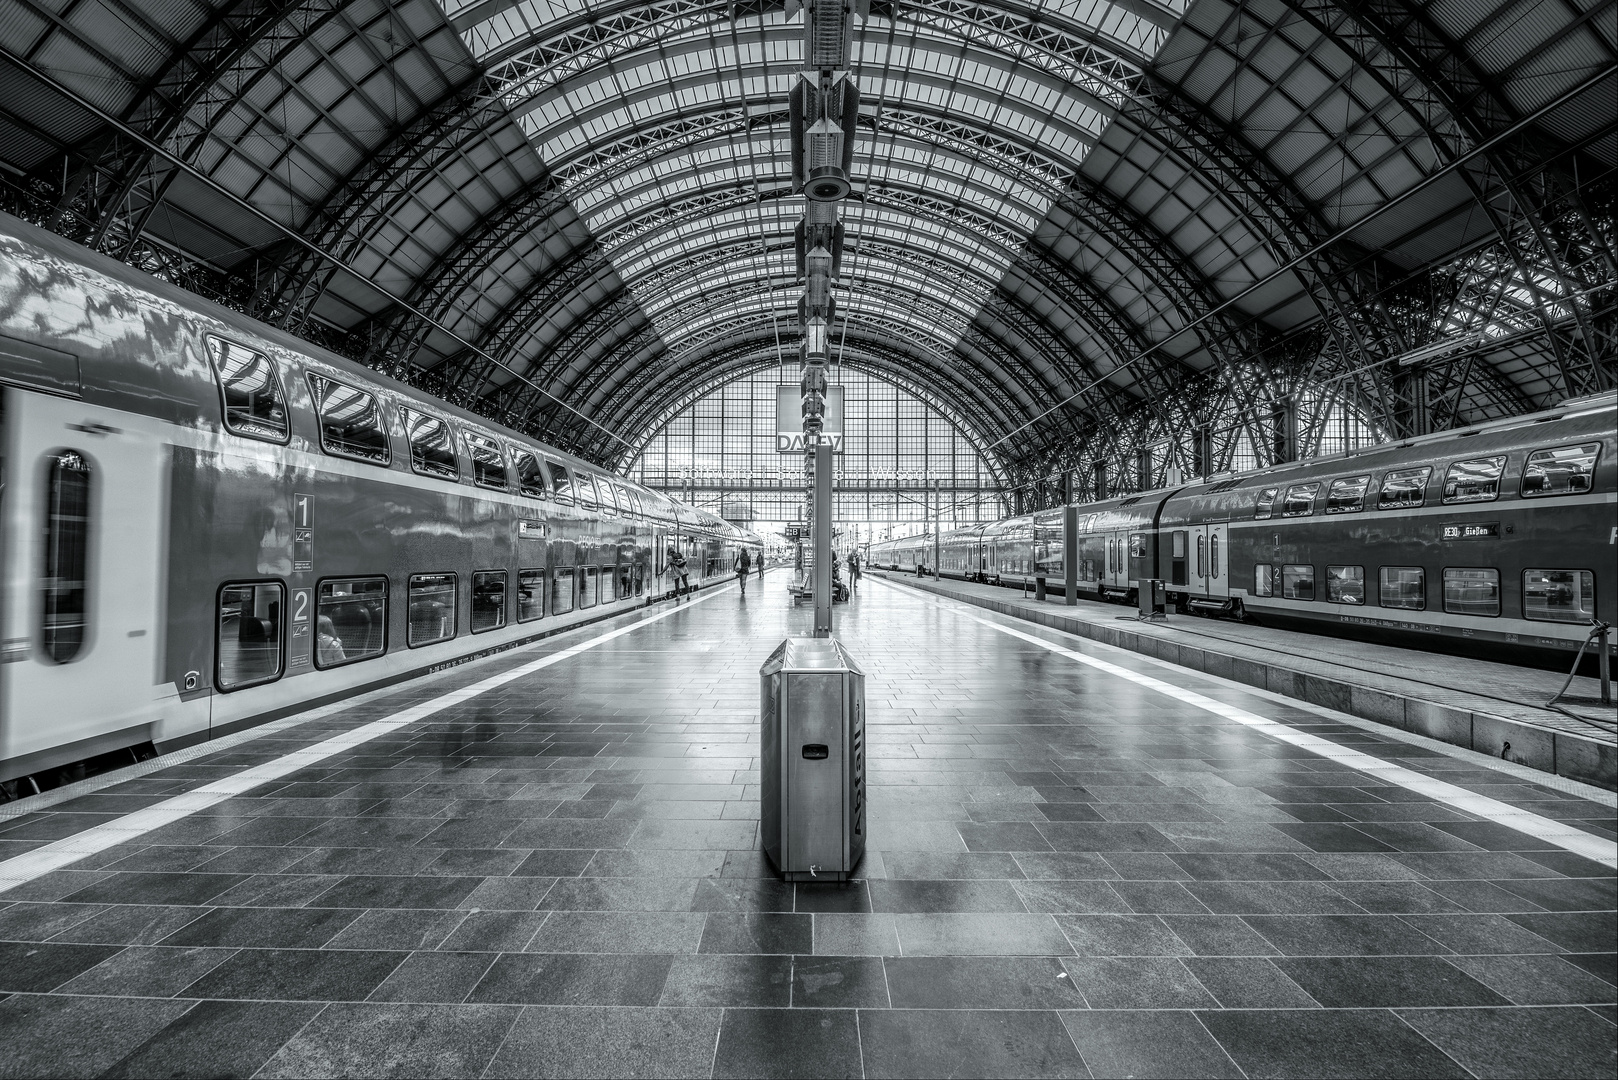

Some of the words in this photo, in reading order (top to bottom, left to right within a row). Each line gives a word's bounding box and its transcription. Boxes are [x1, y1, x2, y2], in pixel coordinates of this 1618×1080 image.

[778, 435, 841, 450] DAV
[678, 464, 753, 480] Software
[776, 464, 844, 481] Sere
[870, 465, 936, 481] Wissen
[298, 497, 308, 527] 1
[792, 528, 798, 536] B
[1465, 526, 1488, 535] Gießen
[1274, 534, 1279, 546] 1
[1274, 567, 1280, 579] 2
[294, 591, 308, 621] 2
[854, 729, 862, 836] Abfall
